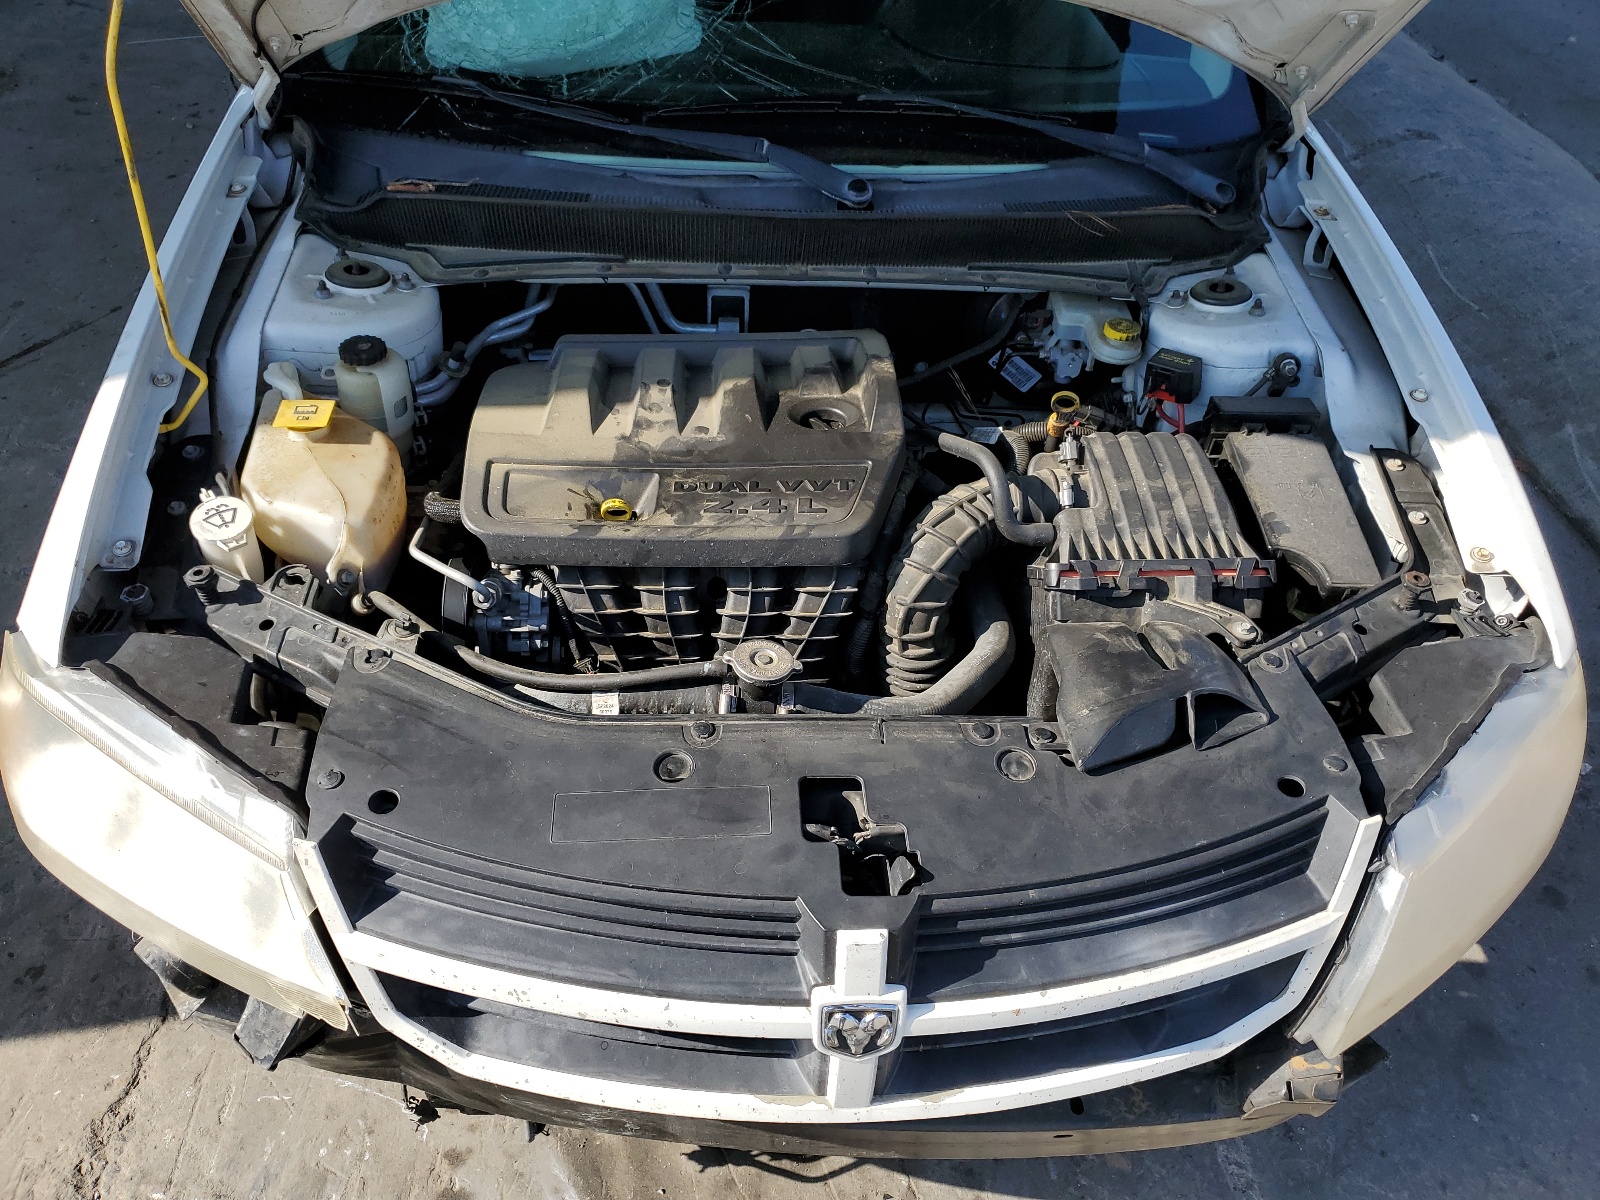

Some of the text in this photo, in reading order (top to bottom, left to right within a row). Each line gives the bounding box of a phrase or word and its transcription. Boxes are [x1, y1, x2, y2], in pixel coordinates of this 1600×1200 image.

[672, 479, 855, 494] DUAL VVT
[701, 498, 828, 515] 2.4L
